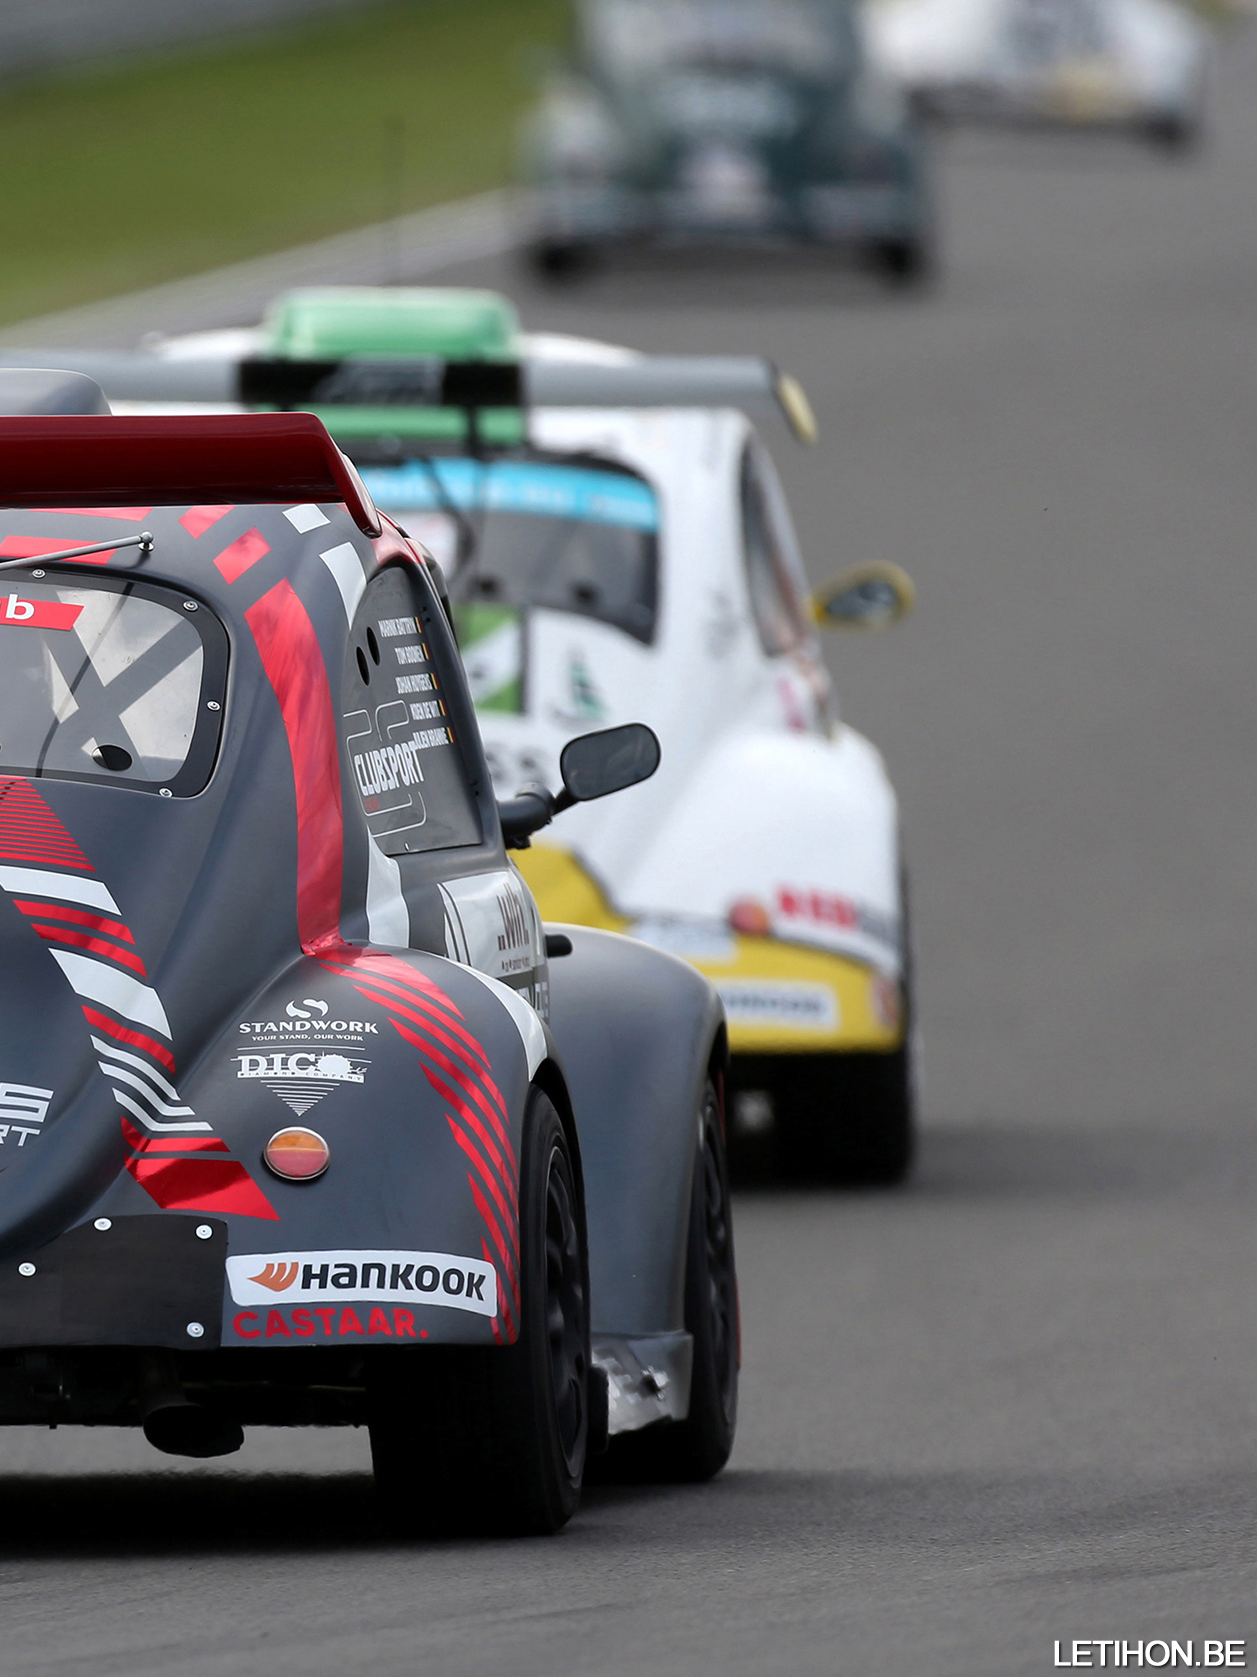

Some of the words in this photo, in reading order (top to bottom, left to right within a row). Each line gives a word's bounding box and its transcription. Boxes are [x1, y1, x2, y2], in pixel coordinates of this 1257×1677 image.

[354, 740, 424, 796] CLUBSPORT
[239, 1020, 379, 1034] STANDWORK
[232, 1307, 429, 1339] CASTAAR.
